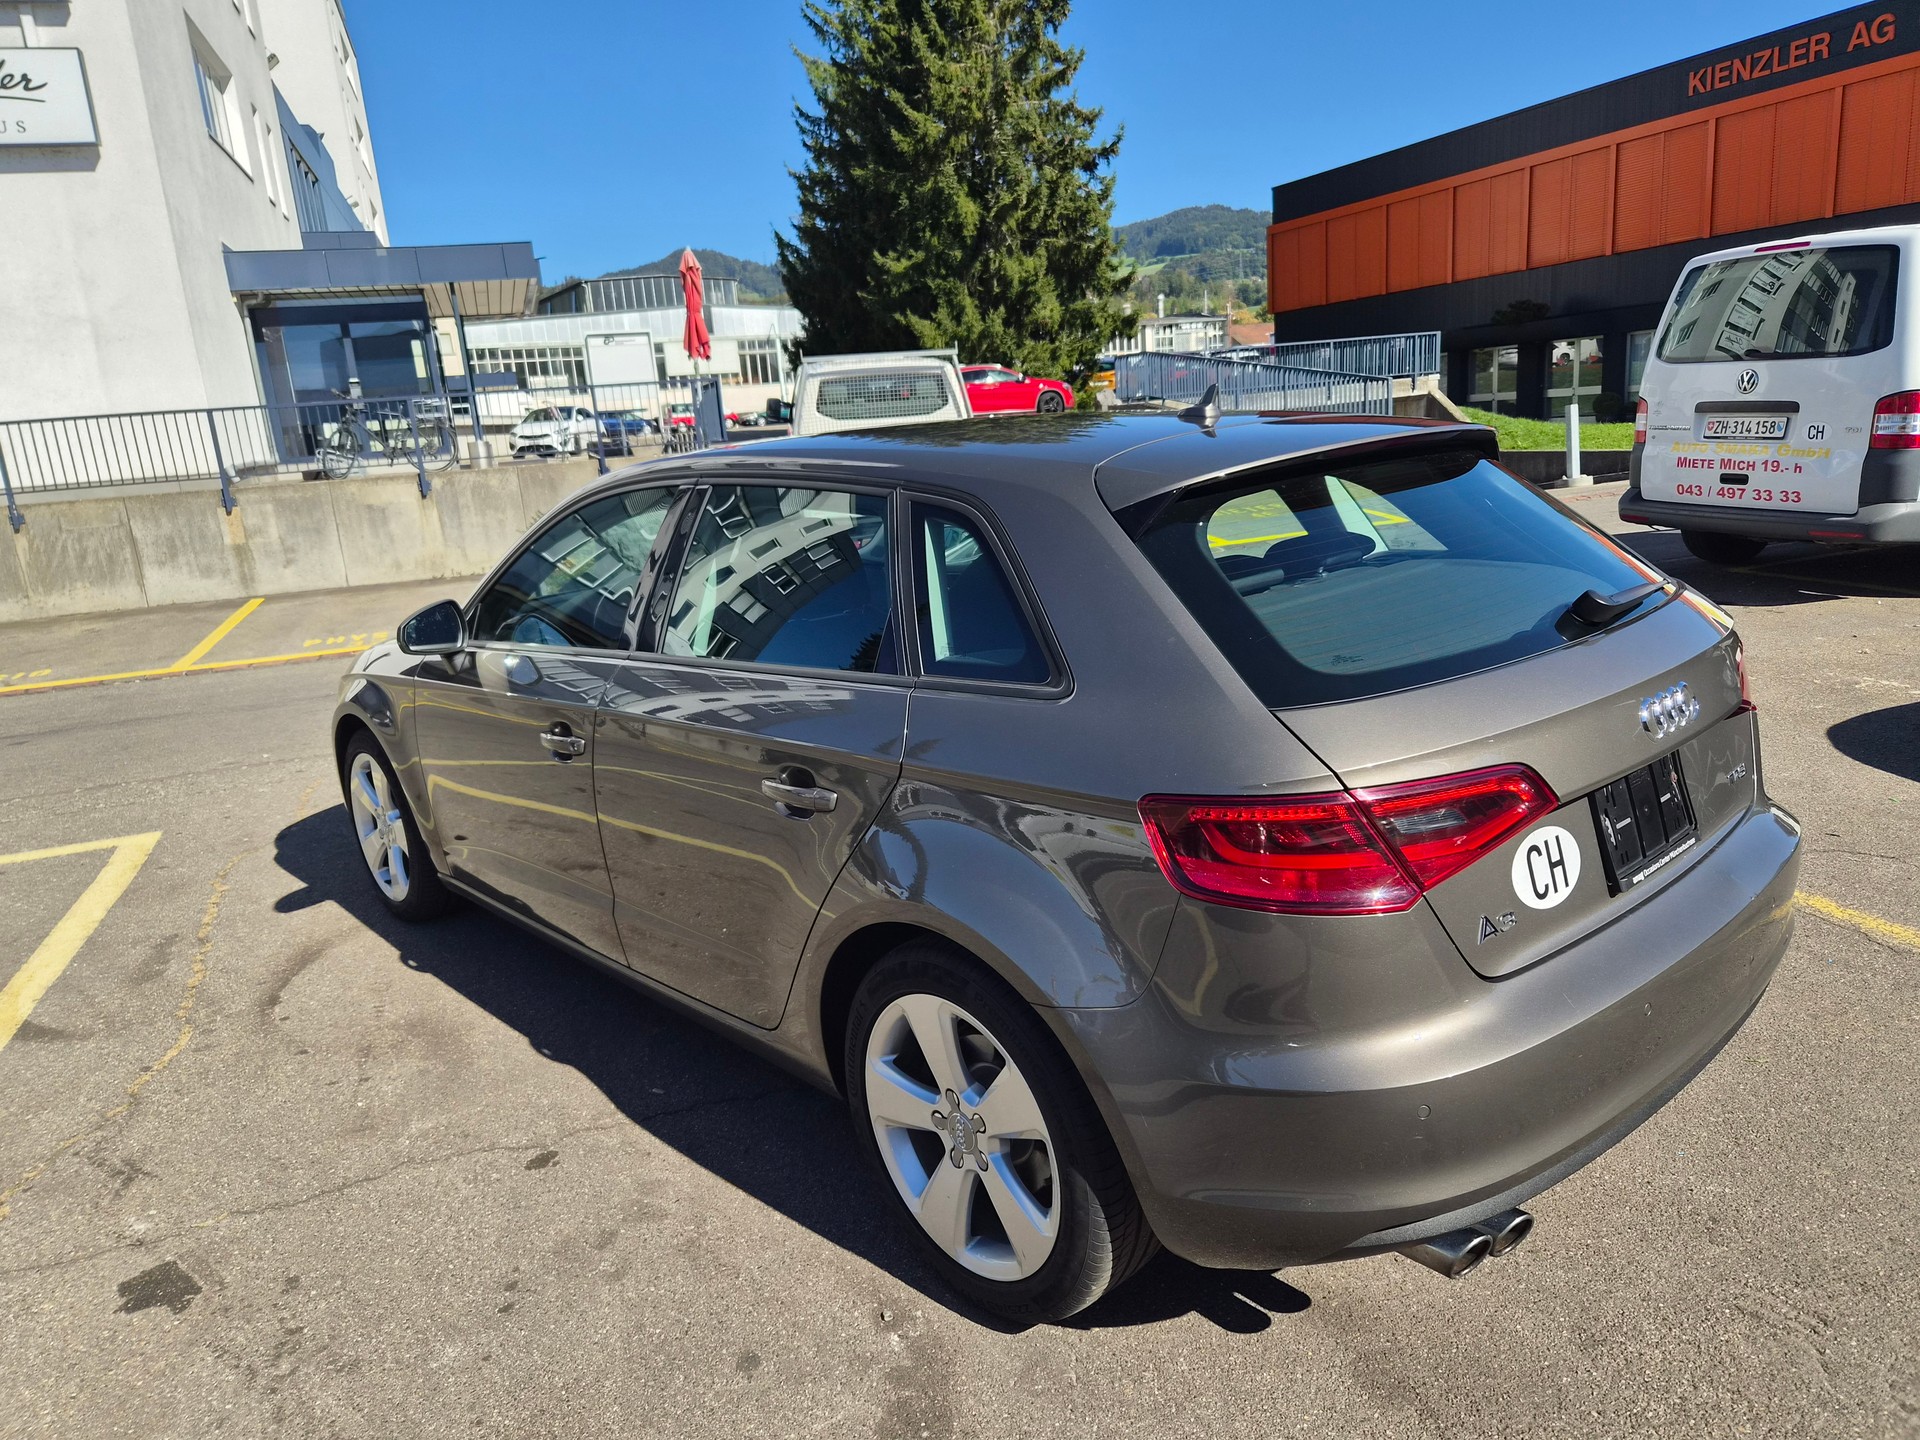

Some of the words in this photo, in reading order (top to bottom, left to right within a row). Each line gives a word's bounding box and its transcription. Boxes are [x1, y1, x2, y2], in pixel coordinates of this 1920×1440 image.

[1687, 31, 1832, 97] KIENZLER
[1846, 12, 1897, 53] AG
[0, 59, 48, 91] er
[1807, 425, 1825, 440] CH
[1670, 441, 1709, 454] AUTO
[1776, 444, 1831, 459] GmbH
[1676, 457, 1715, 469] MIETE
[1719, 458, 1756, 471] MICH
[1794, 463, 1802, 473] h
[1676, 484, 1703, 496] 043
[1716, 487, 1746, 499] 497
[1752, 489, 1773, 501] 33
[1779, 490, 1802, 503] 33
[1526, 834, 1570, 901] CH
[1478, 911, 1517, 945] A3
